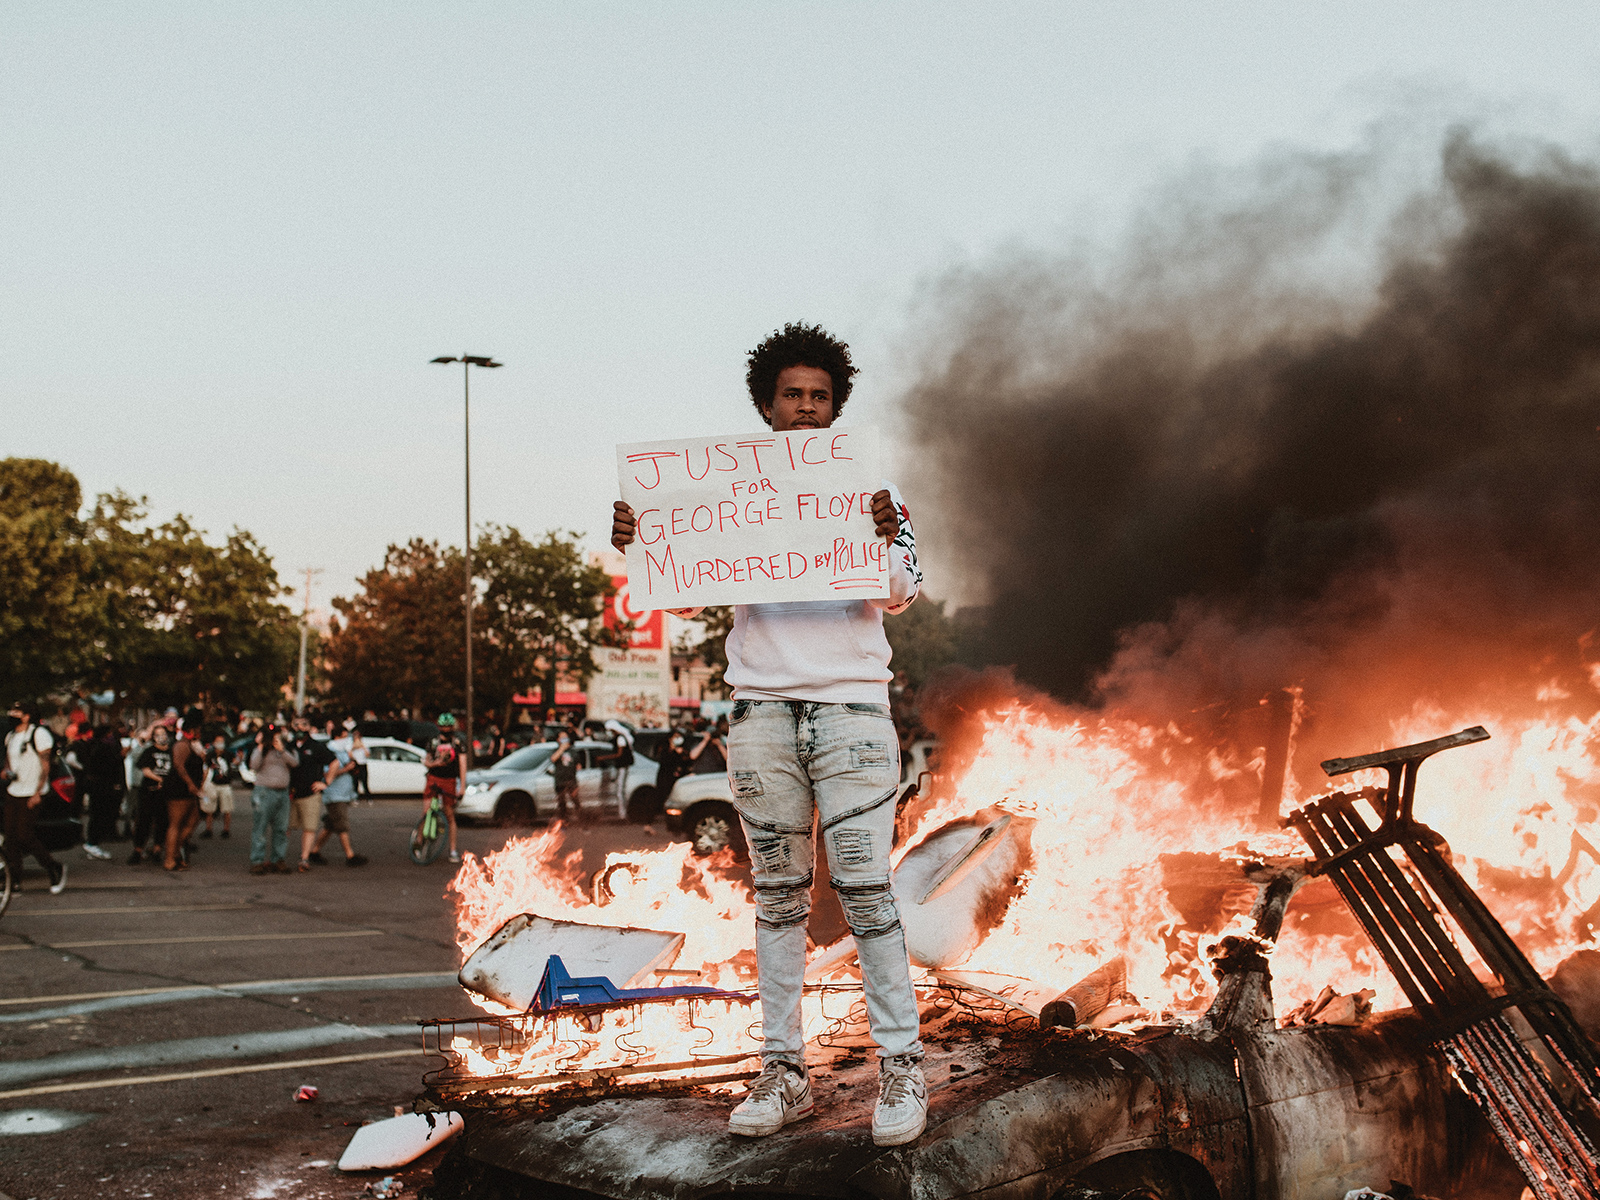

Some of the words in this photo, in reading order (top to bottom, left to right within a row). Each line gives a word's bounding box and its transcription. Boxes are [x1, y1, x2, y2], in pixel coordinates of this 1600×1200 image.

[626, 433, 853, 490] JUSTICE
[731, 477, 779, 498] FOR
[637, 497, 783, 545] GEORGE
[645, 543, 808, 595] MURDERED
[814, 551, 832, 568] BY
[833, 537, 887, 577] POLICE
